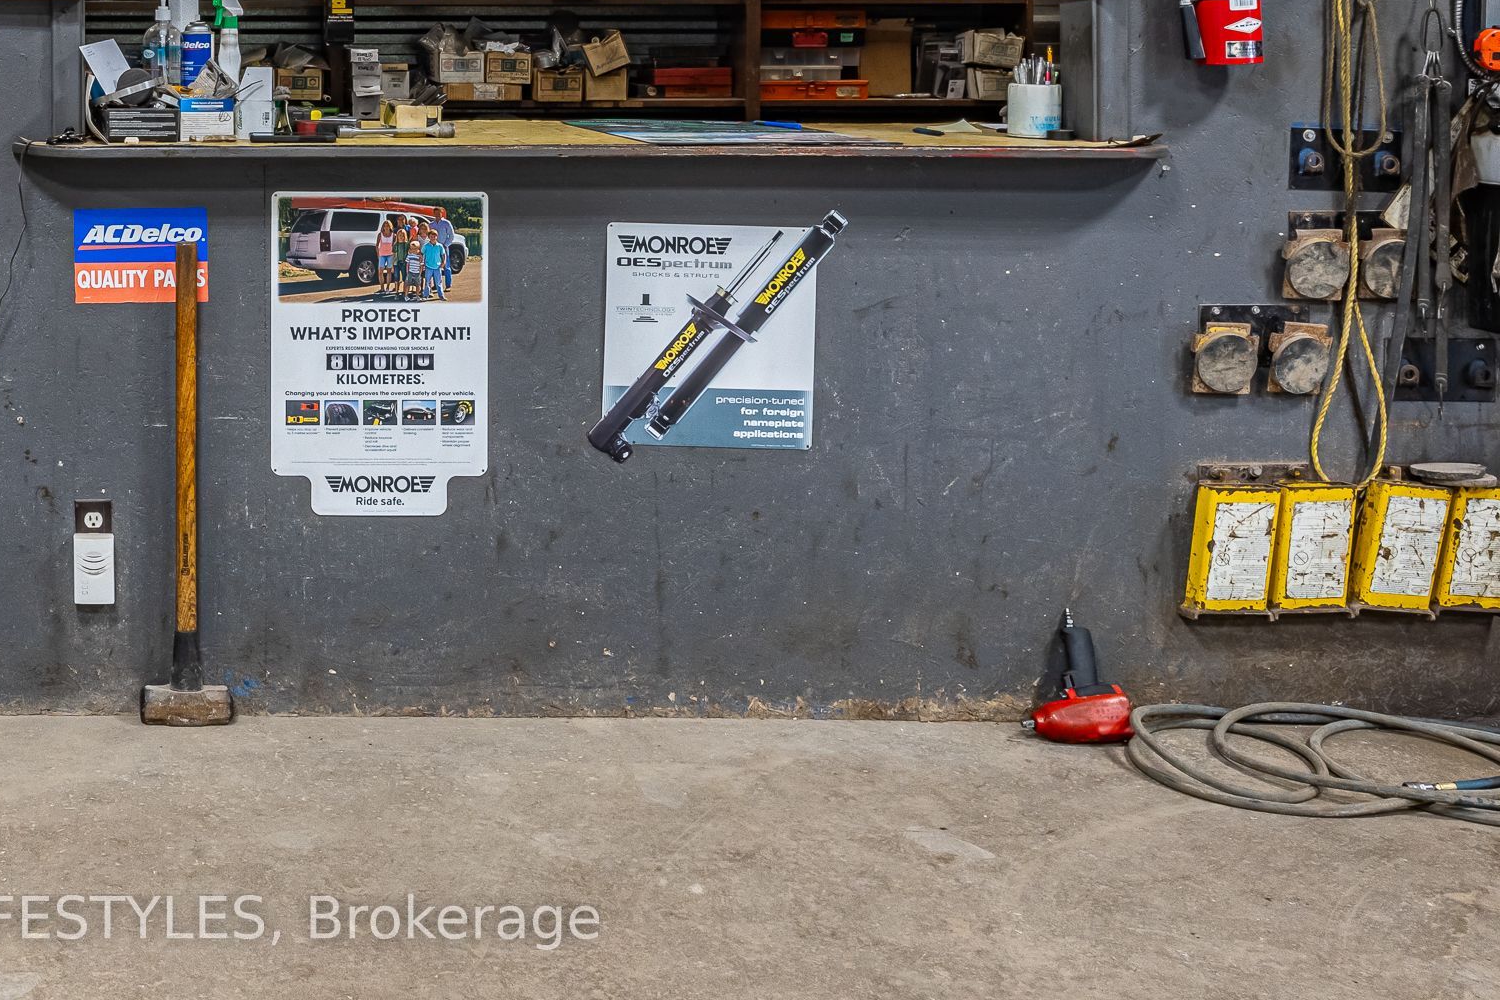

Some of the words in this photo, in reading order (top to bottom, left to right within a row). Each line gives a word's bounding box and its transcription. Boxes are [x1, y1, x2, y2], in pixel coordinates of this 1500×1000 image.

[83, 224, 203, 243] ACDelco
[625, 235, 724, 255] MONROE
[616, 257, 733, 270] OESpectrum
[77, 269, 148, 289] QUALITY
[154, 269, 206, 288] PAS
[758, 251, 804, 305] MONROE
[765, 257, 815, 314] OESpectrum
[341, 309, 420, 322] PROTECT
[363, 327, 471, 340] IMPORTANT!
[657, 325, 696, 368] MONROE
[663, 330, 705, 378] OESpectrum
[716, 396, 805, 406] precision-tuned
[740, 407, 759, 416] for
[762, 407, 805, 417] foreign
[743, 419, 804, 428] nameplate
[733, 430, 804, 439] applications
[334, 476, 425, 493] MONROE
[356, 497, 378, 505] Ride
[381, 497, 405, 506] safe.
